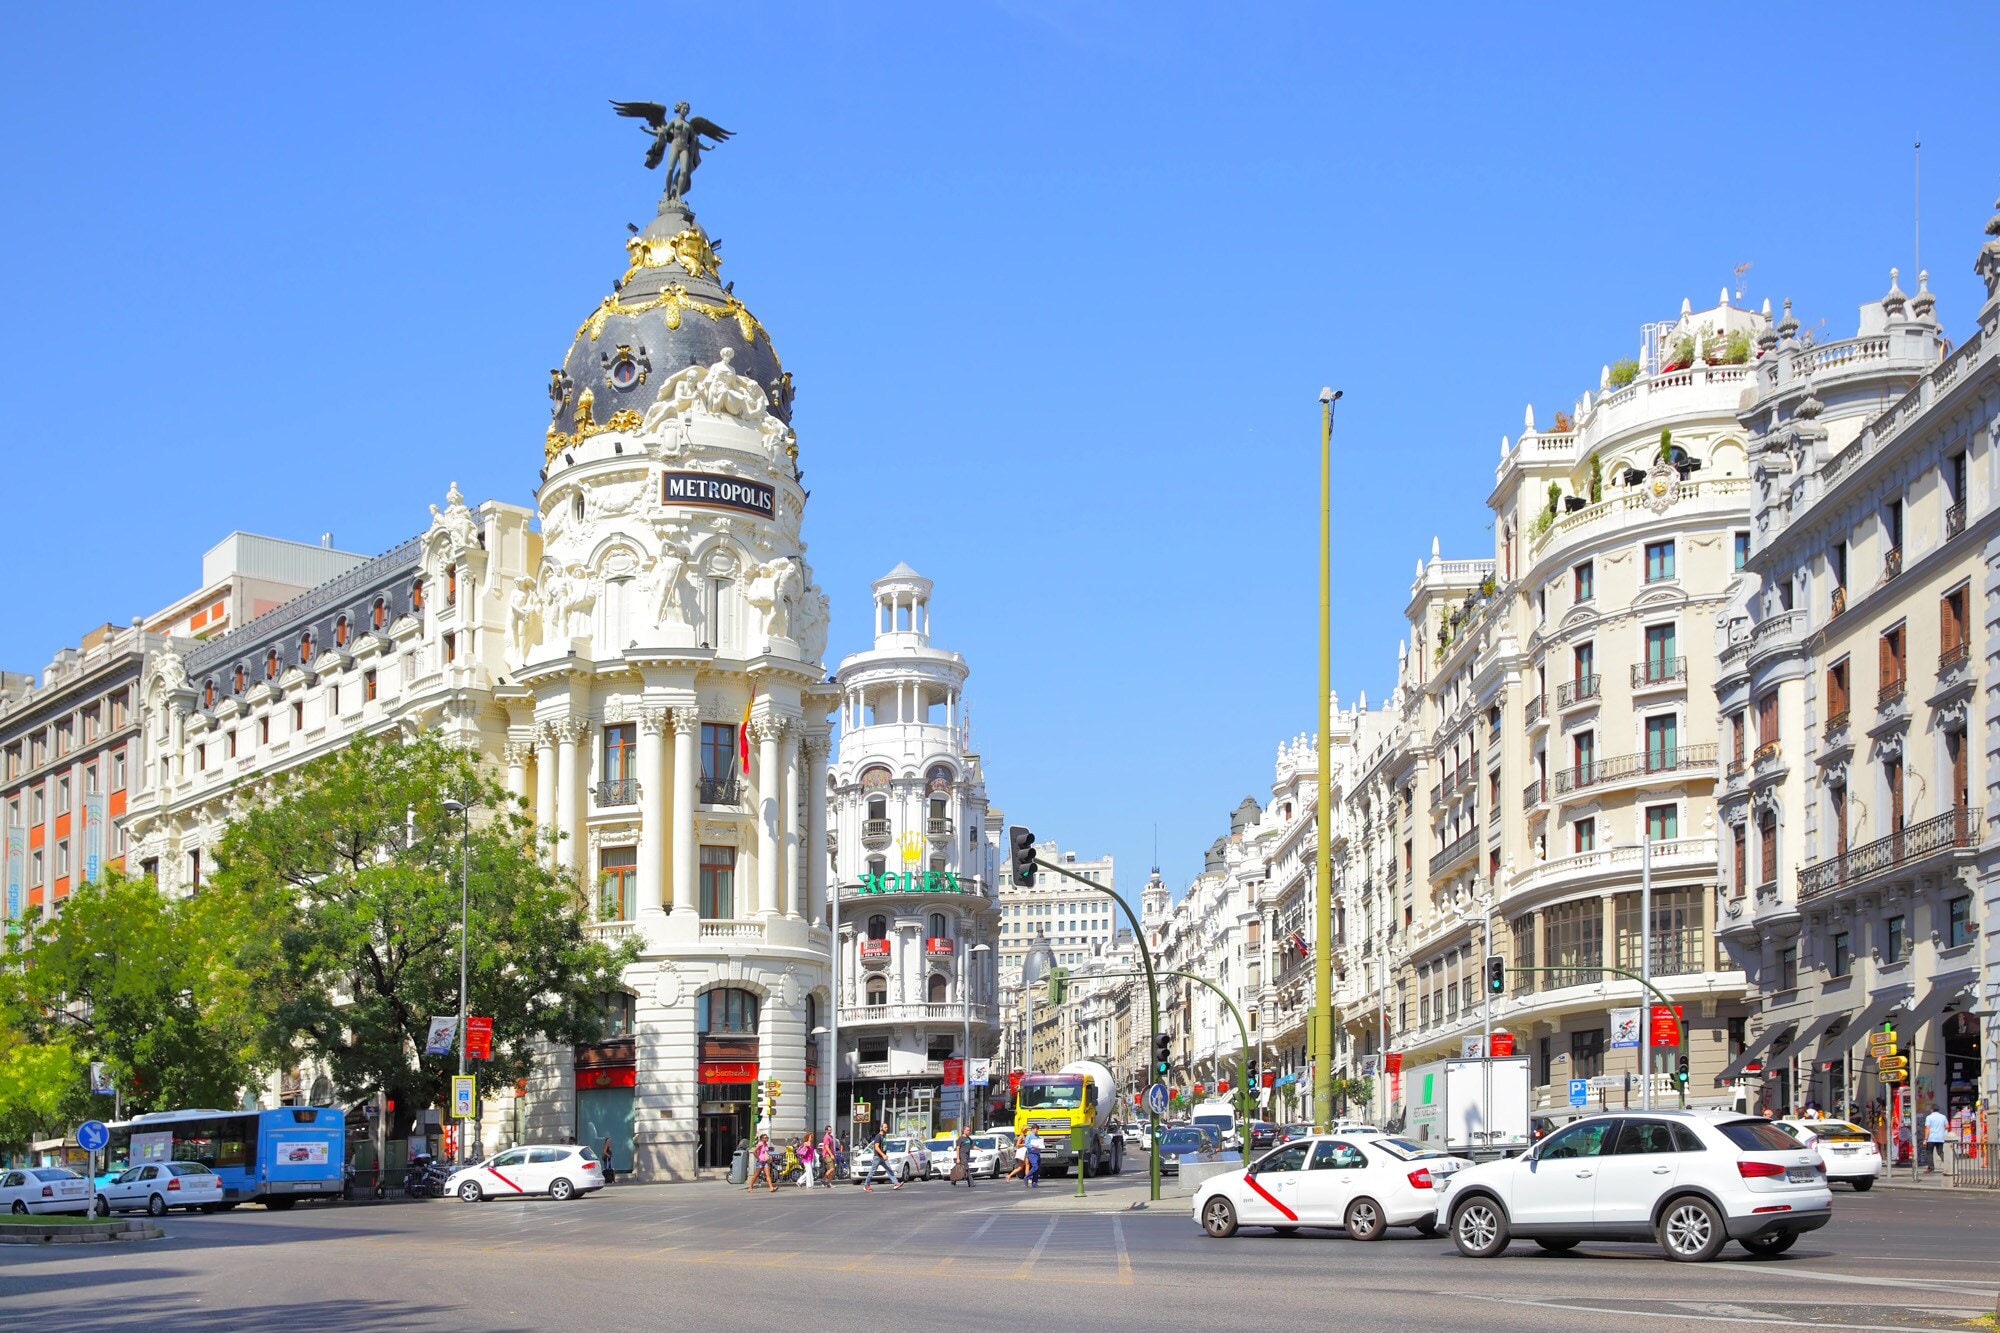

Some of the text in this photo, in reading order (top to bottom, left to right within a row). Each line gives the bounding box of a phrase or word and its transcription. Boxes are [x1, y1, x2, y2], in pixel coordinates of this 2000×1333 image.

[670, 479, 771, 510] METROPOLIS
[858, 871, 963, 894] ROLEX
[1571, 1081, 1581, 1095] P
